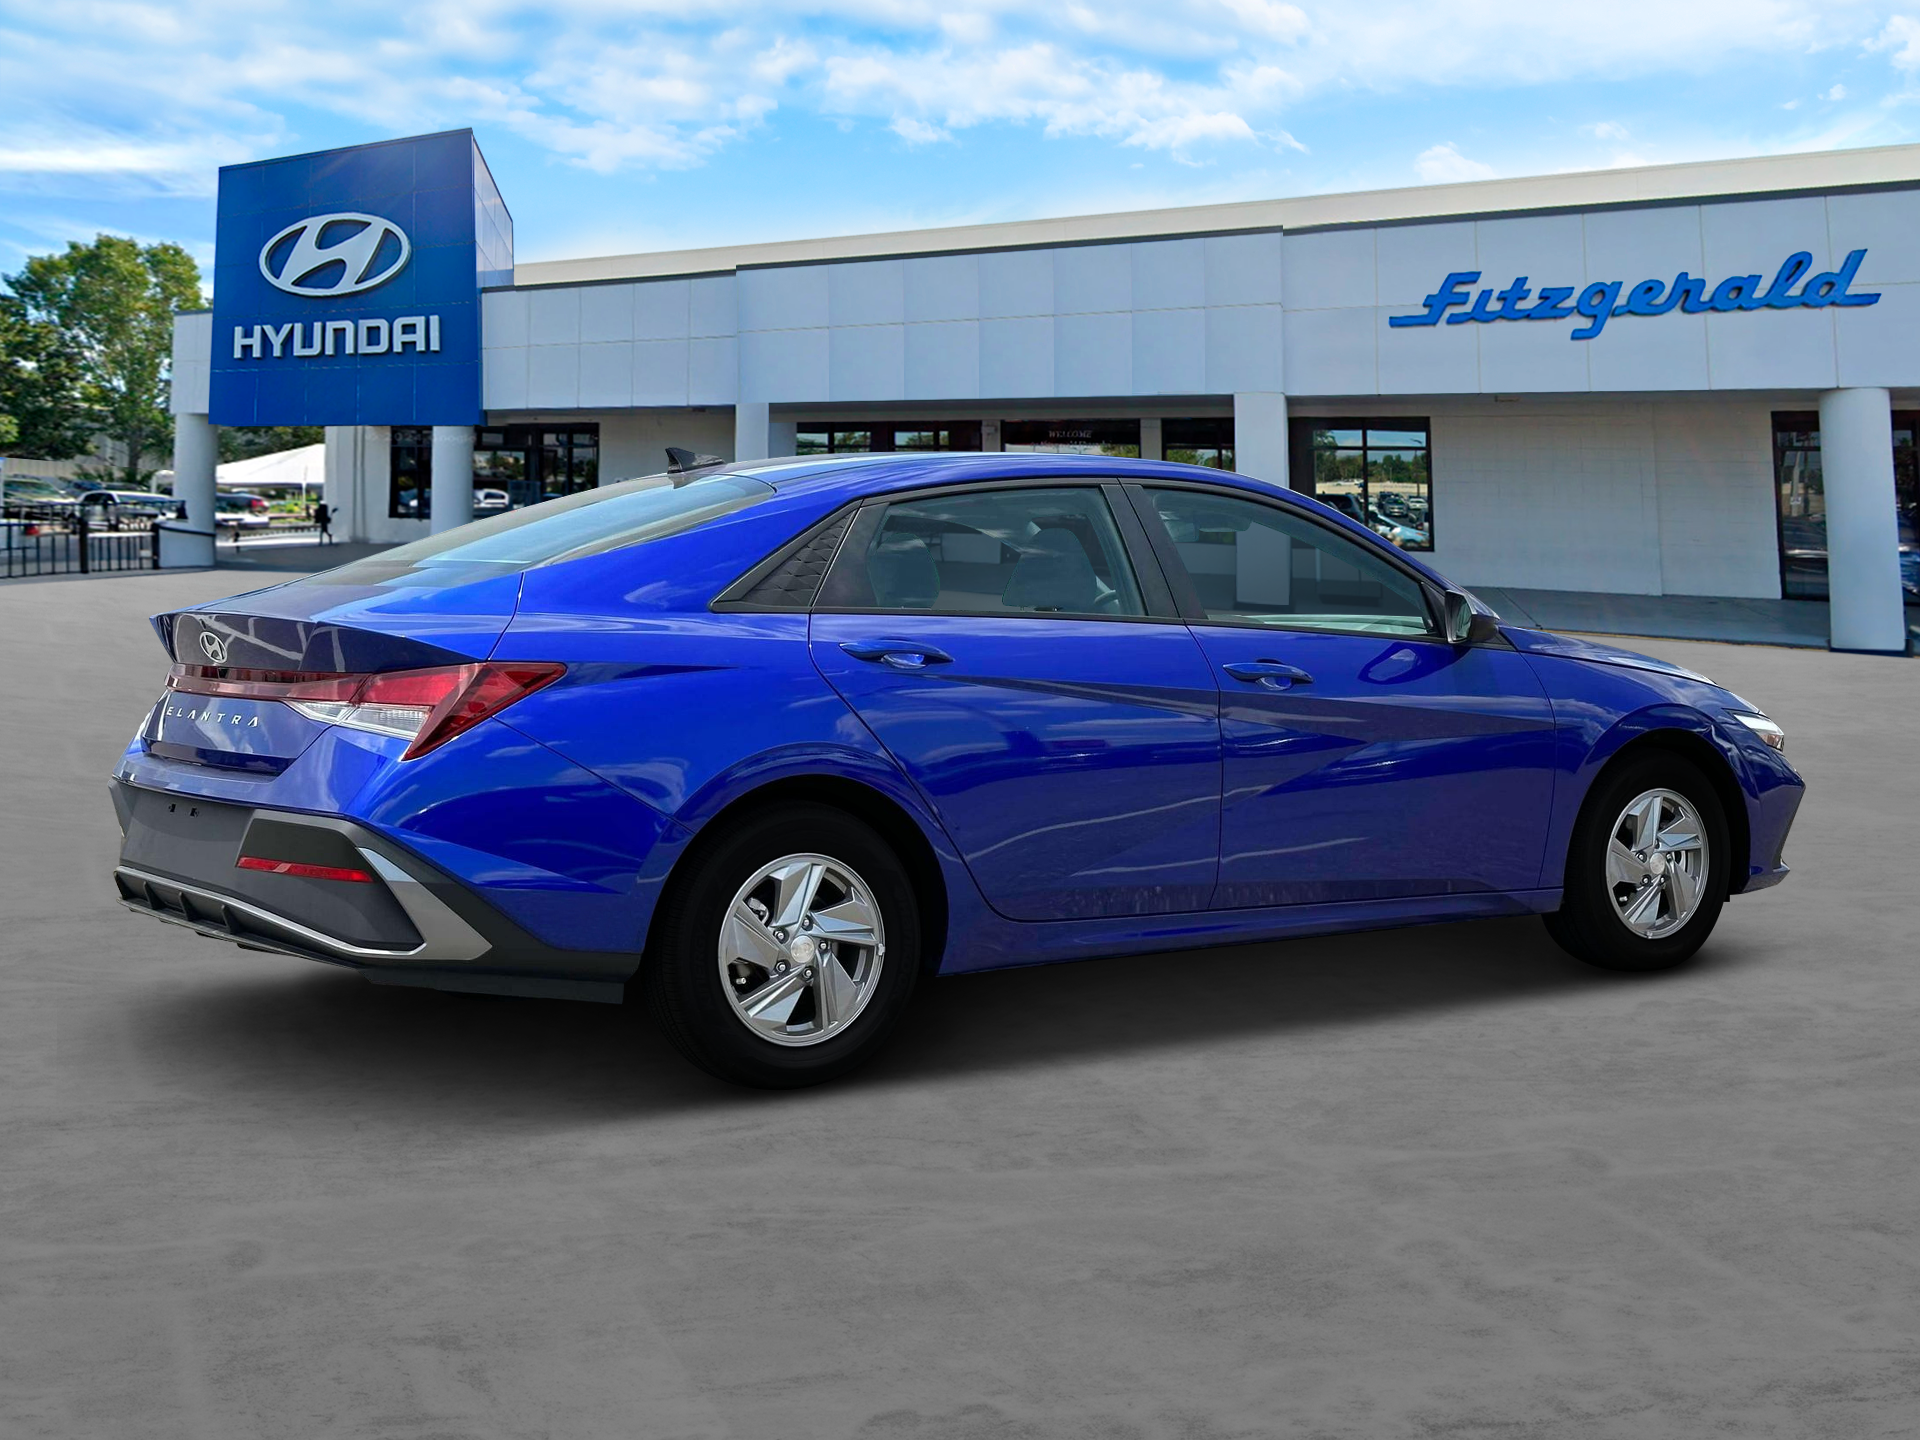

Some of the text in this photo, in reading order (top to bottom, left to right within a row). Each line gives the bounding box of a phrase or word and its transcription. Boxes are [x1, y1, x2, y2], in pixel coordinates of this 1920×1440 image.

[1389, 248, 1882, 341] Fitzgerald
[233, 314, 441, 359] HYUNDAI
[165, 706, 259, 728] ELANTRA
